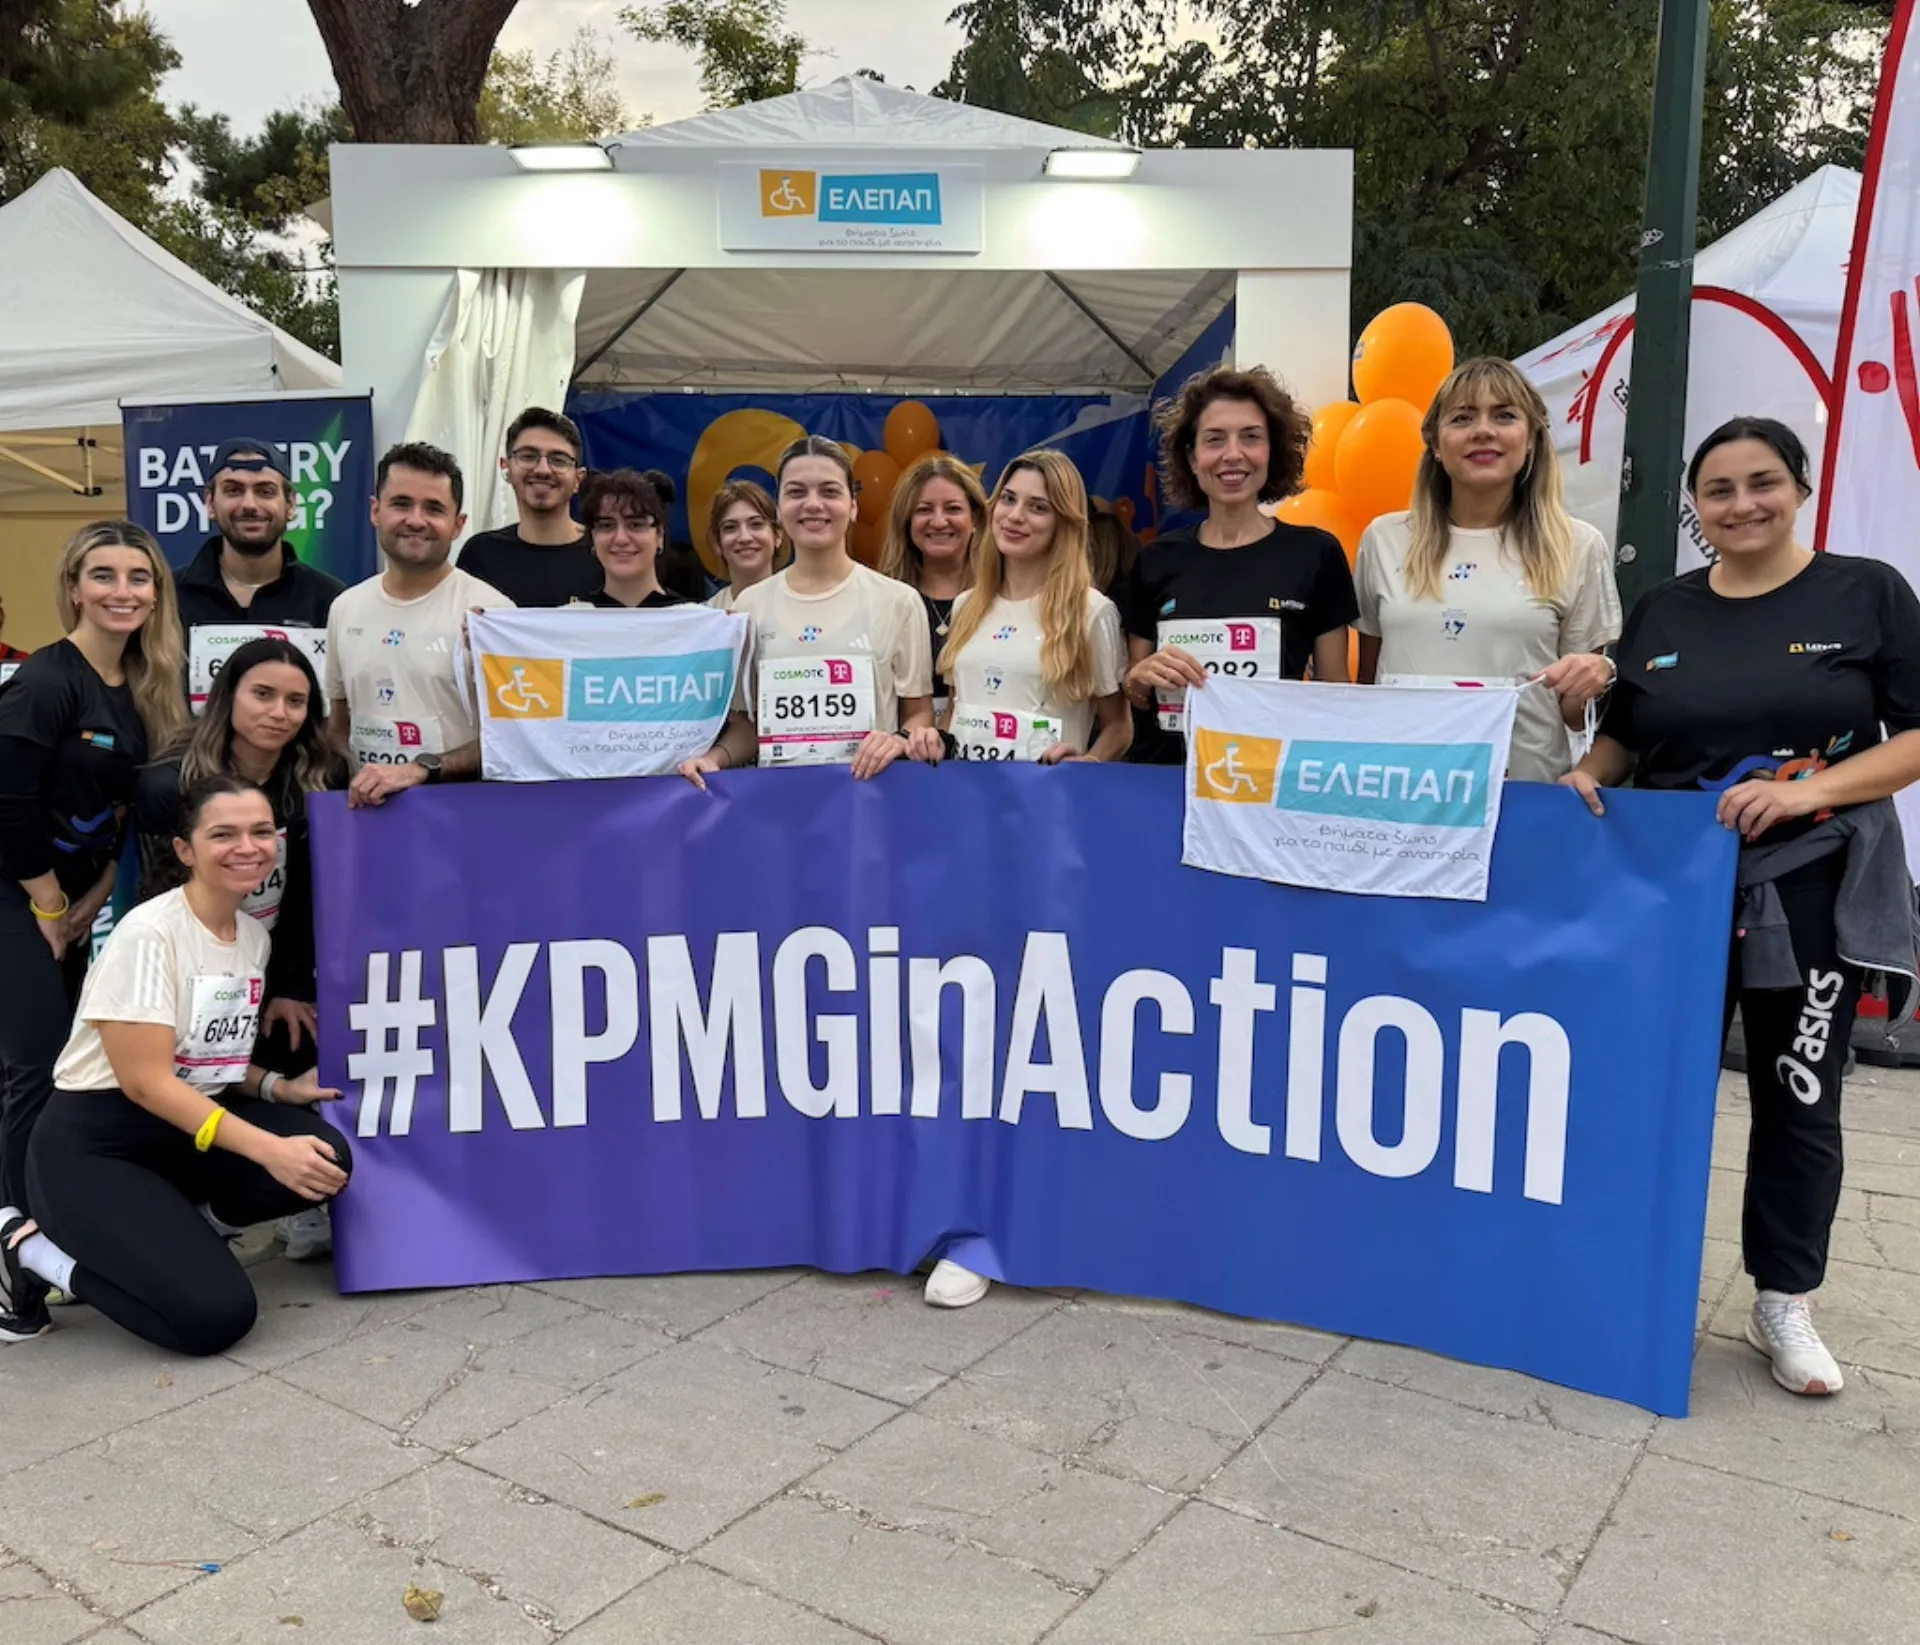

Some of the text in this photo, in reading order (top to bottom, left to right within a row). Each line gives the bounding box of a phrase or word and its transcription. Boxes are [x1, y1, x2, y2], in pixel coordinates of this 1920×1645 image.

[829, 188, 932, 211] ΕΛΕΠΑΠ
[139, 440, 352, 489] BARY
[157, 488, 333, 533] DYG?
[208, 635, 255, 645] COSMO
[584, 671, 725, 705] ΕΛΕΠΑΠ
[775, 693, 857, 719] 58159
[1297, 759, 1475, 804] ΕΛΕΠΑΠ
[347, 925, 1572, 1206] #KPMGinAction
